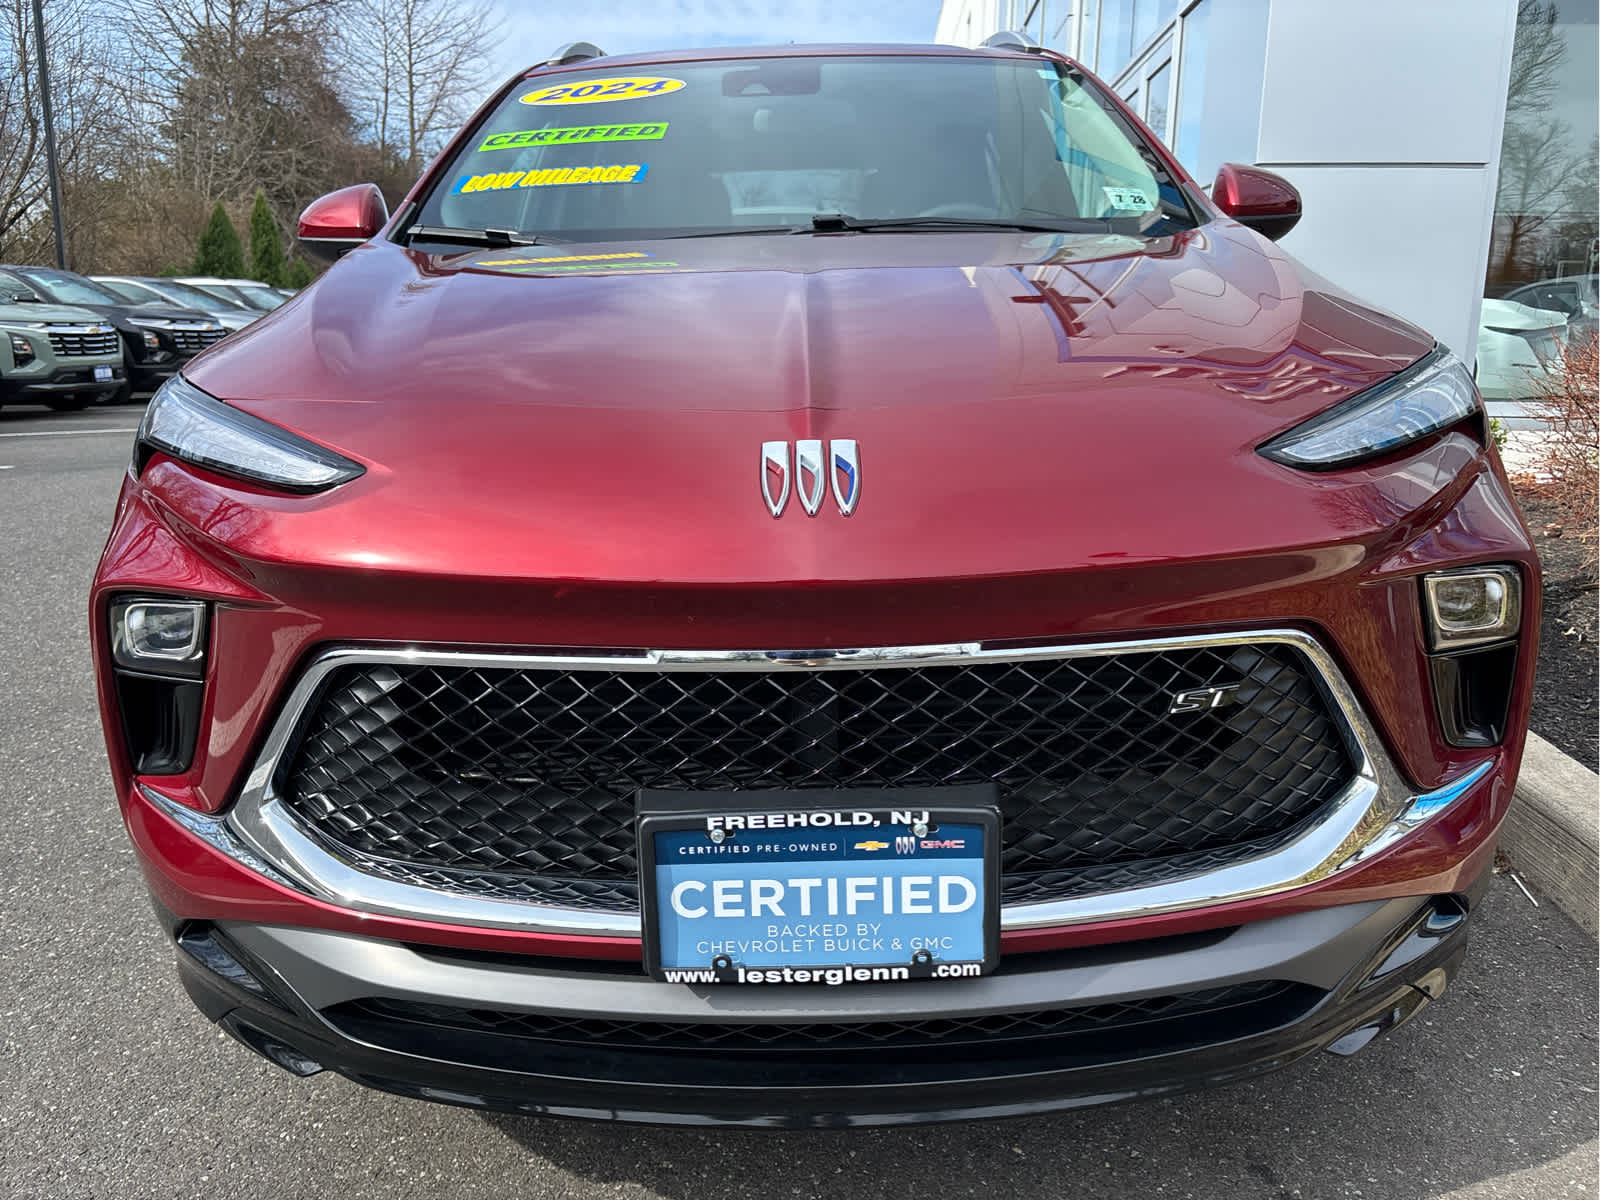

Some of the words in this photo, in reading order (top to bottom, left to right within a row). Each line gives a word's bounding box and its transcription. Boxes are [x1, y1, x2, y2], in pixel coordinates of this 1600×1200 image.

[536, 80, 670, 102] 2024
[485, 124, 660, 146] CERTIFIED
[461, 171, 526, 193] LOW
[519, 165, 641, 187] MILEAGE
[706, 811, 881, 831] FREEHOLD,
[890, 810, 930, 825] NJ
[679, 845, 751, 855] CERTIFIED
[756, 843, 838, 853] PRE-OWNED
[919, 839, 966, 849] GMC
[670, 875, 977, 919] CERTIFIED
[767, 923, 849, 938] BACKED
[856, 922, 882, 936] BY
[696, 939, 816, 954] CHEVROLET
[823, 938, 885, 952] BUICK
[890, 937, 903, 951] &
[909, 936, 954, 950] GMC
[737, 967, 910, 986] lesterglenn
